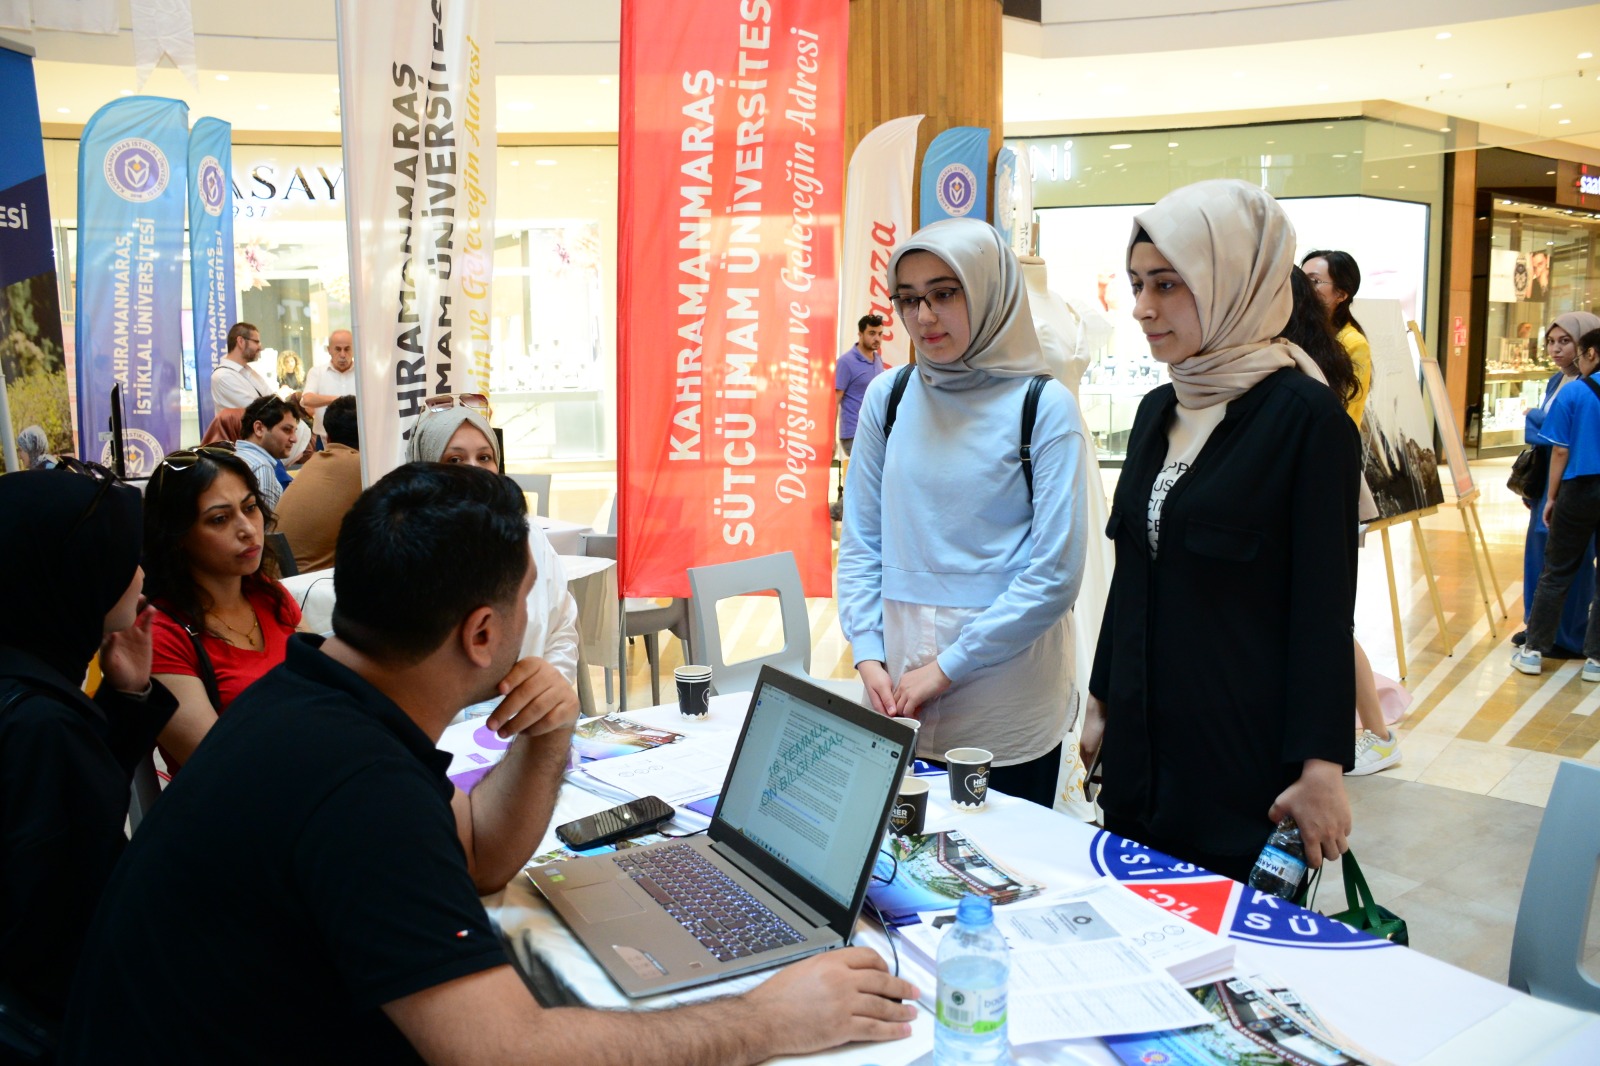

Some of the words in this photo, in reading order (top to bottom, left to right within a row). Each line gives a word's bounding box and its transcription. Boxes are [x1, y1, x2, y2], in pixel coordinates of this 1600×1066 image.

[463, 35, 480, 147] Adresi
[785, 27, 819, 136] Adresi
[461, 152, 489, 300] Geleceğin
[668, 69, 724, 461] KAHRAMANMARAŞ
[780, 142, 824, 293] Geleceğin
[134, 217, 155, 335] ÜNİVERSİTESİ
[469, 308, 489, 342] ve
[787, 301, 811, 334] ve
[133, 338, 153, 415] İSTİKLAL
[435, 296, 452, 394] MAM
[715, 287, 760, 399] İMAM
[774, 346, 817, 504] Değişimin
[973, 777, 987, 787] HER
